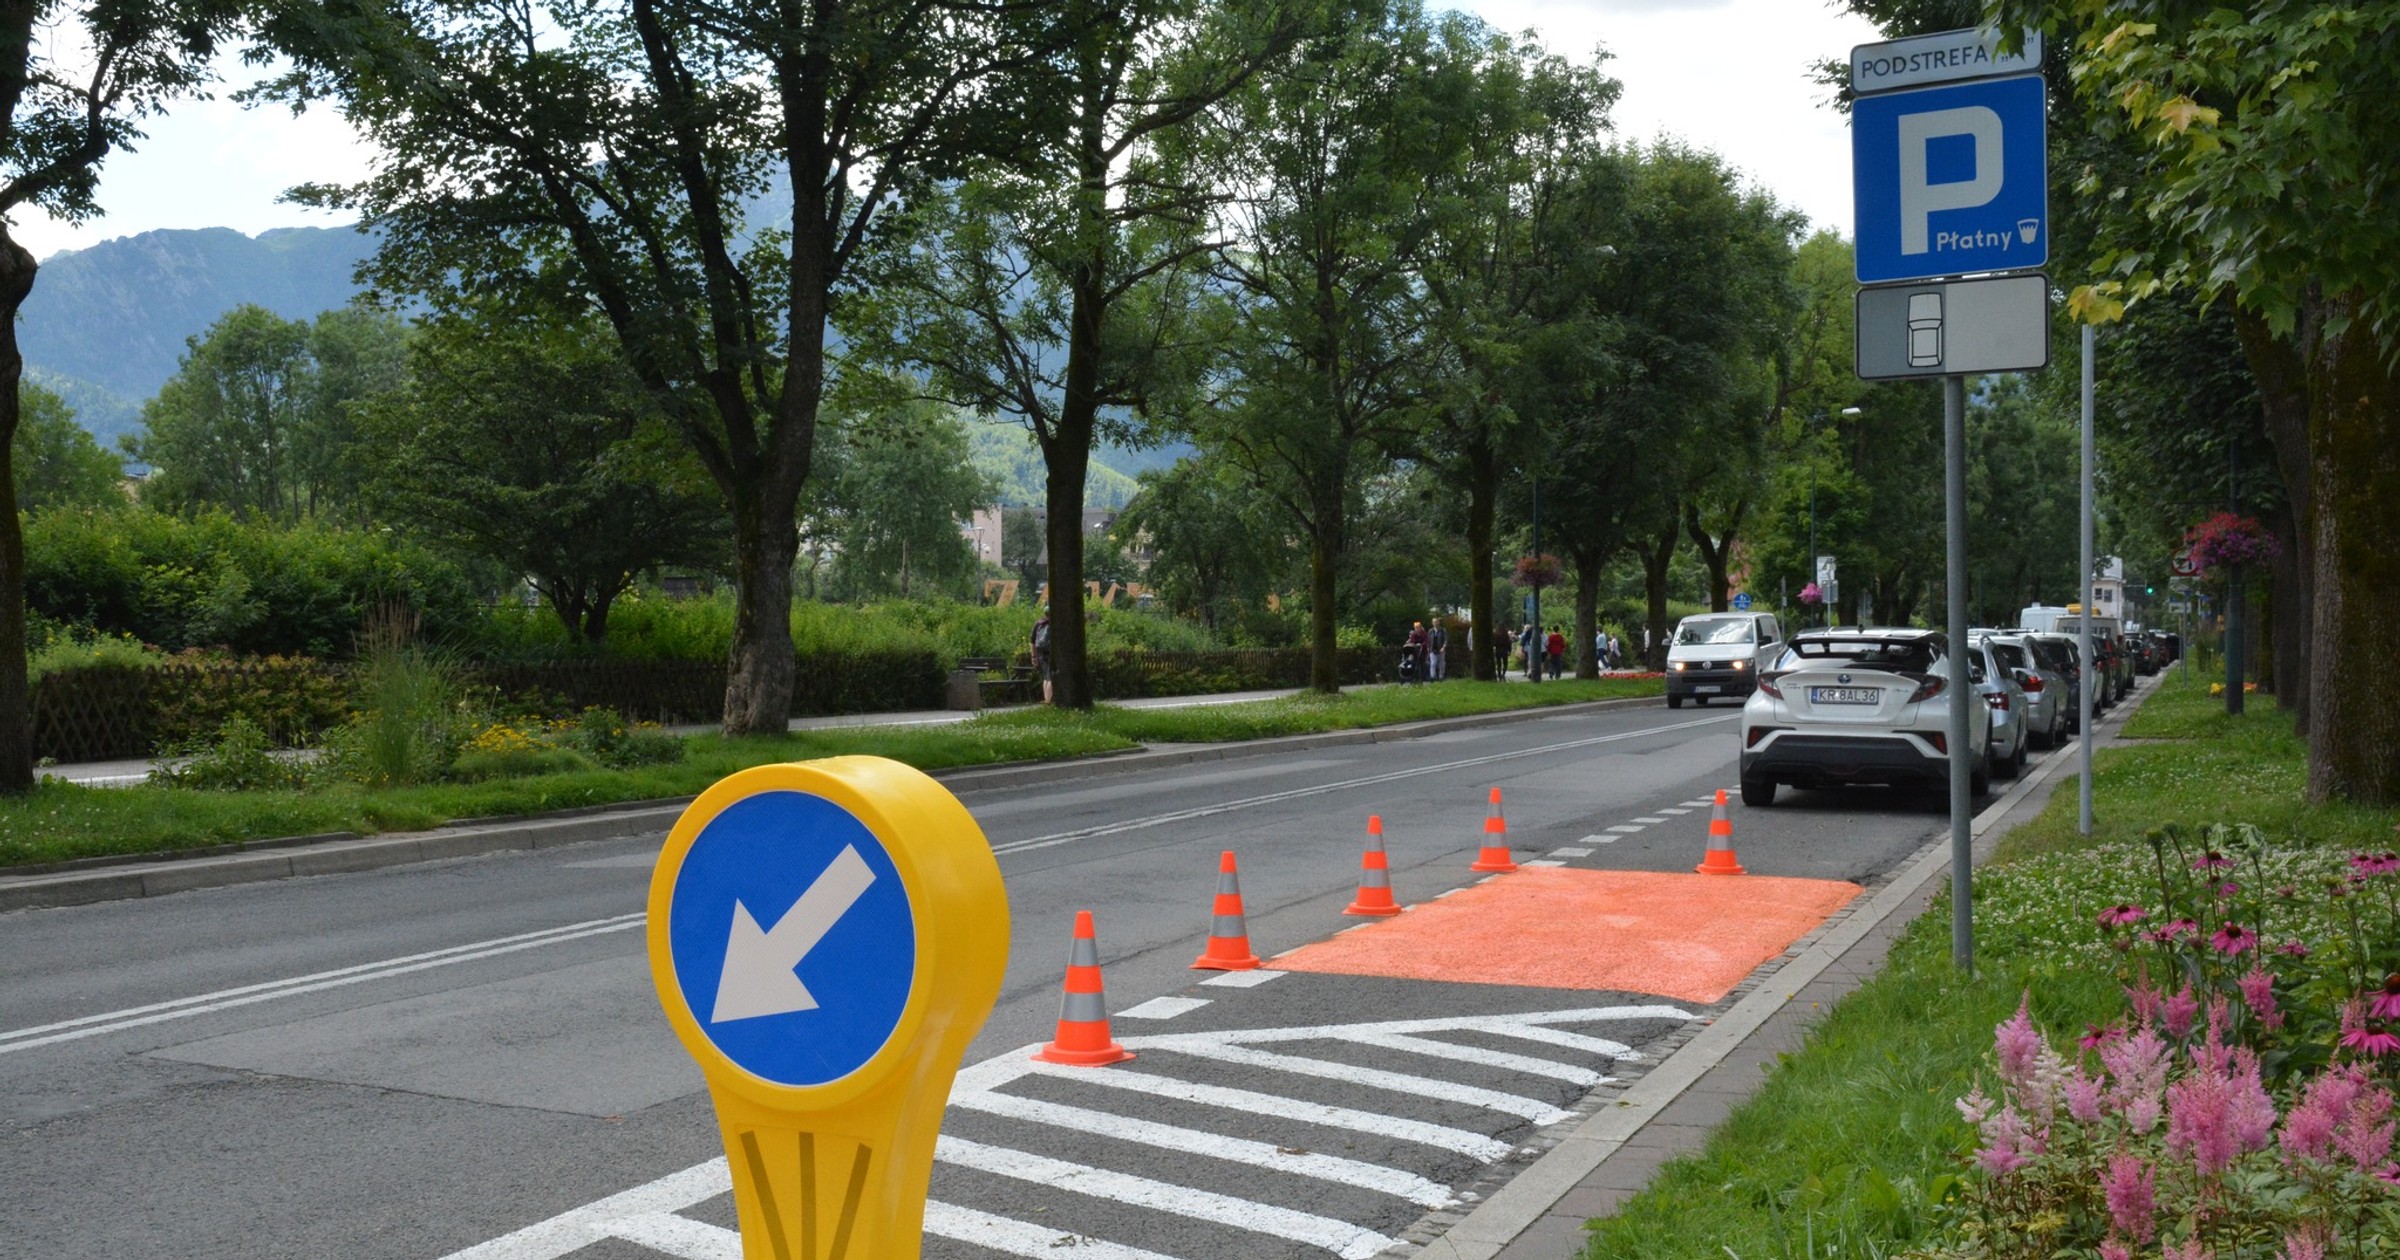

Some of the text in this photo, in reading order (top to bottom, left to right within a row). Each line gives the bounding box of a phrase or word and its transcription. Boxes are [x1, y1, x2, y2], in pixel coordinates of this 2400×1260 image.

[1862, 44, 1988, 78] PODSTREFA
[1898, 105, 2004, 256] P
[1937, 228, 2013, 252] Płatny
[1819, 689, 1876, 701] KR 8AL36
